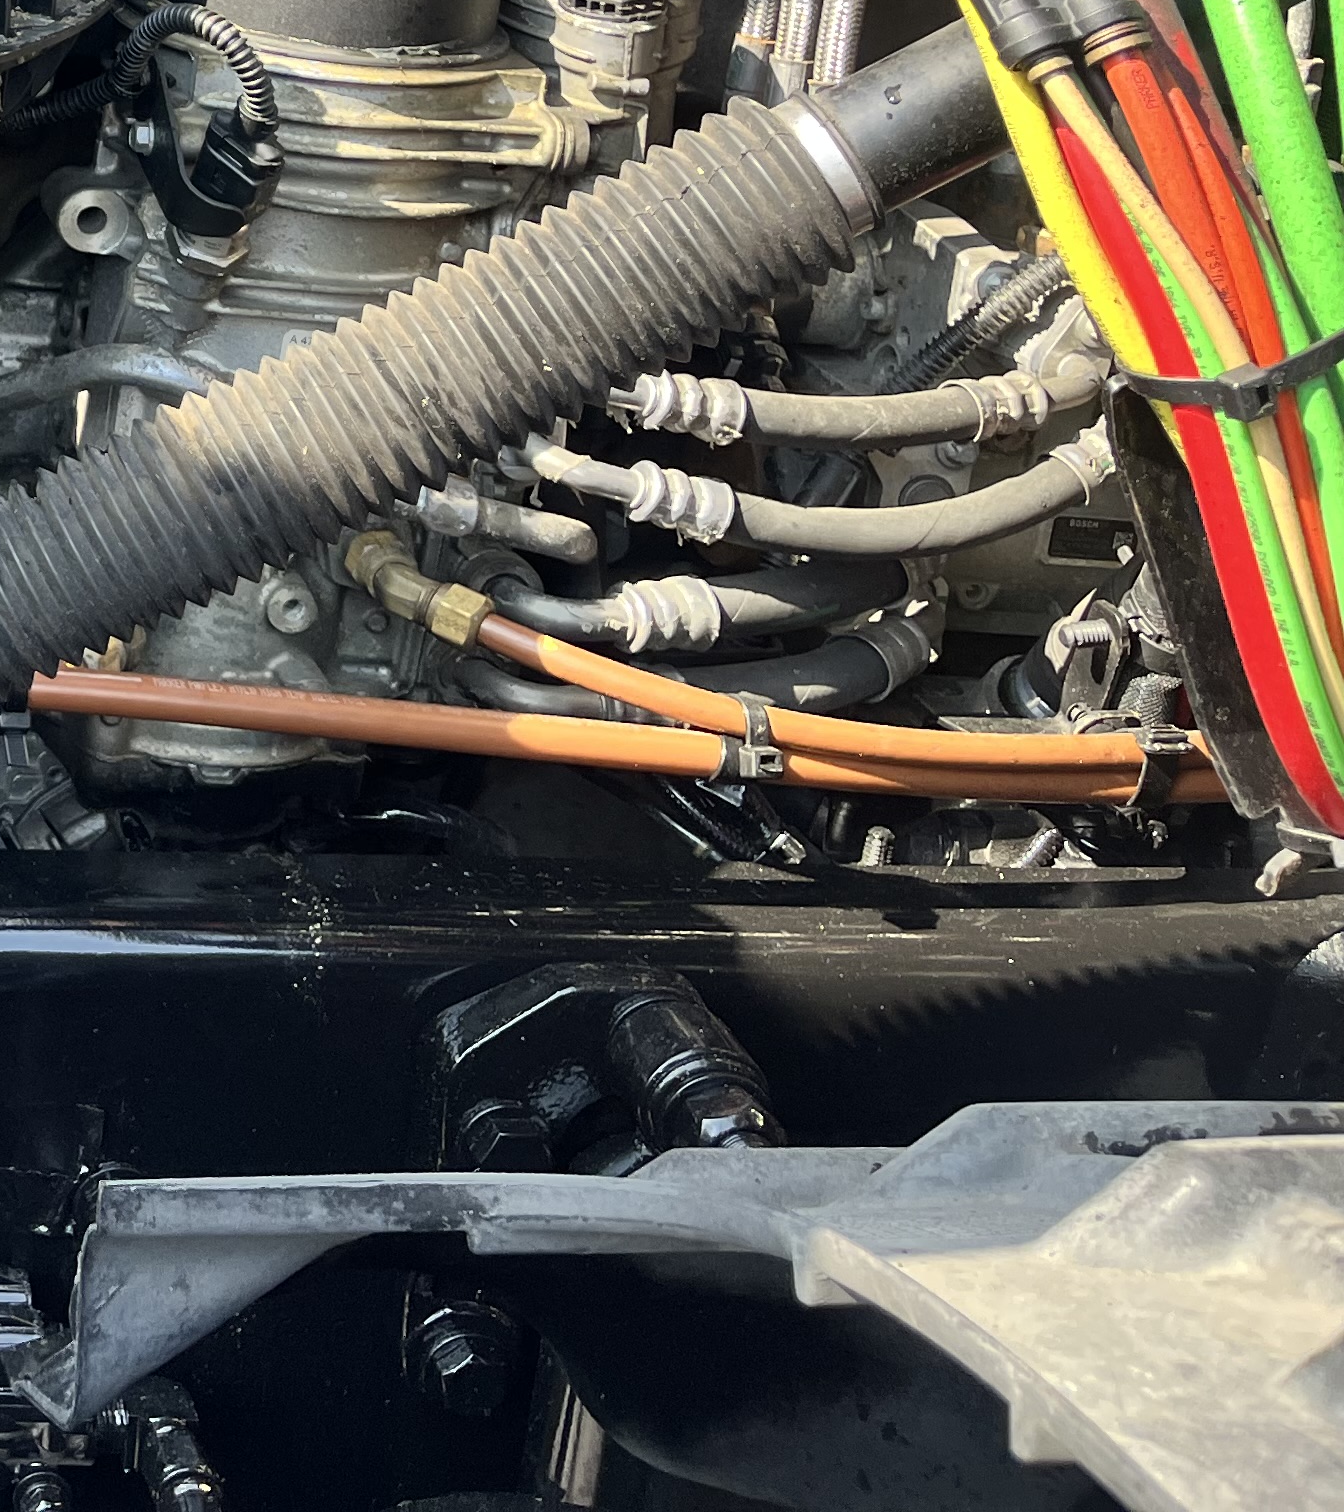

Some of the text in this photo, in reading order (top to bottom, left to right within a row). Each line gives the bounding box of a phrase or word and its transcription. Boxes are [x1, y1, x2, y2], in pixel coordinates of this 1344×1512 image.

[1176, 313, 1198, 342] TYPE
[1069, 518, 1100, 529] BOSCH
[1256, 549, 1278, 599] EXTRUDED
